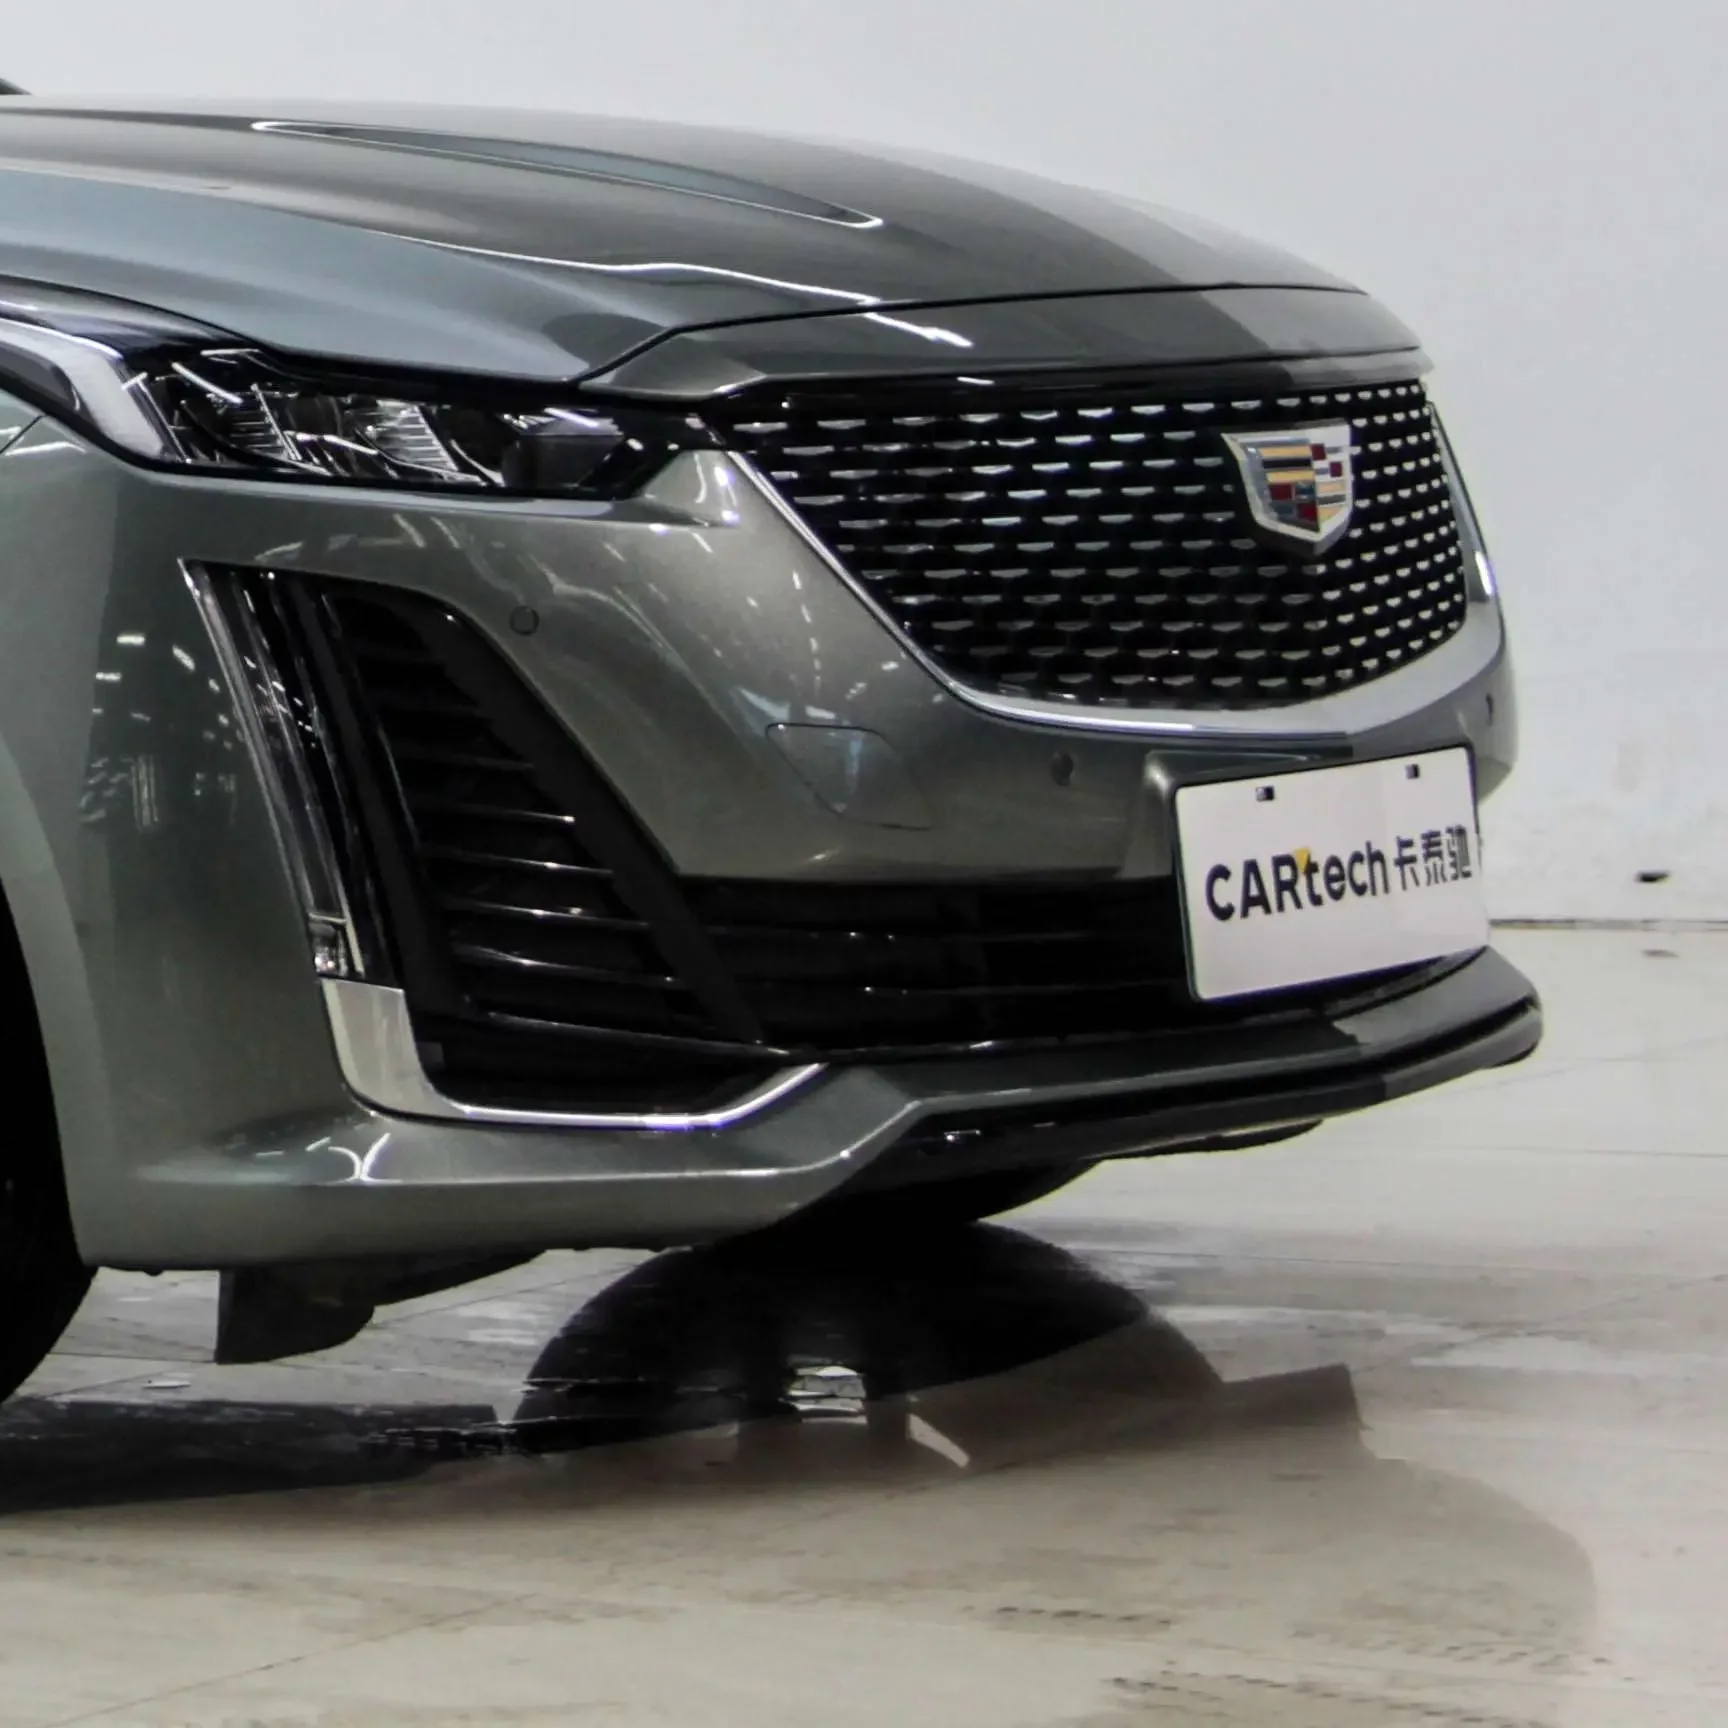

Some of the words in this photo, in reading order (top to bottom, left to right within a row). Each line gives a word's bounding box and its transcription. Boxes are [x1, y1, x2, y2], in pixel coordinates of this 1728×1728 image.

[1205, 841, 1389, 922] CARtech
[1394, 824, 1473, 892] 卡泰驰
